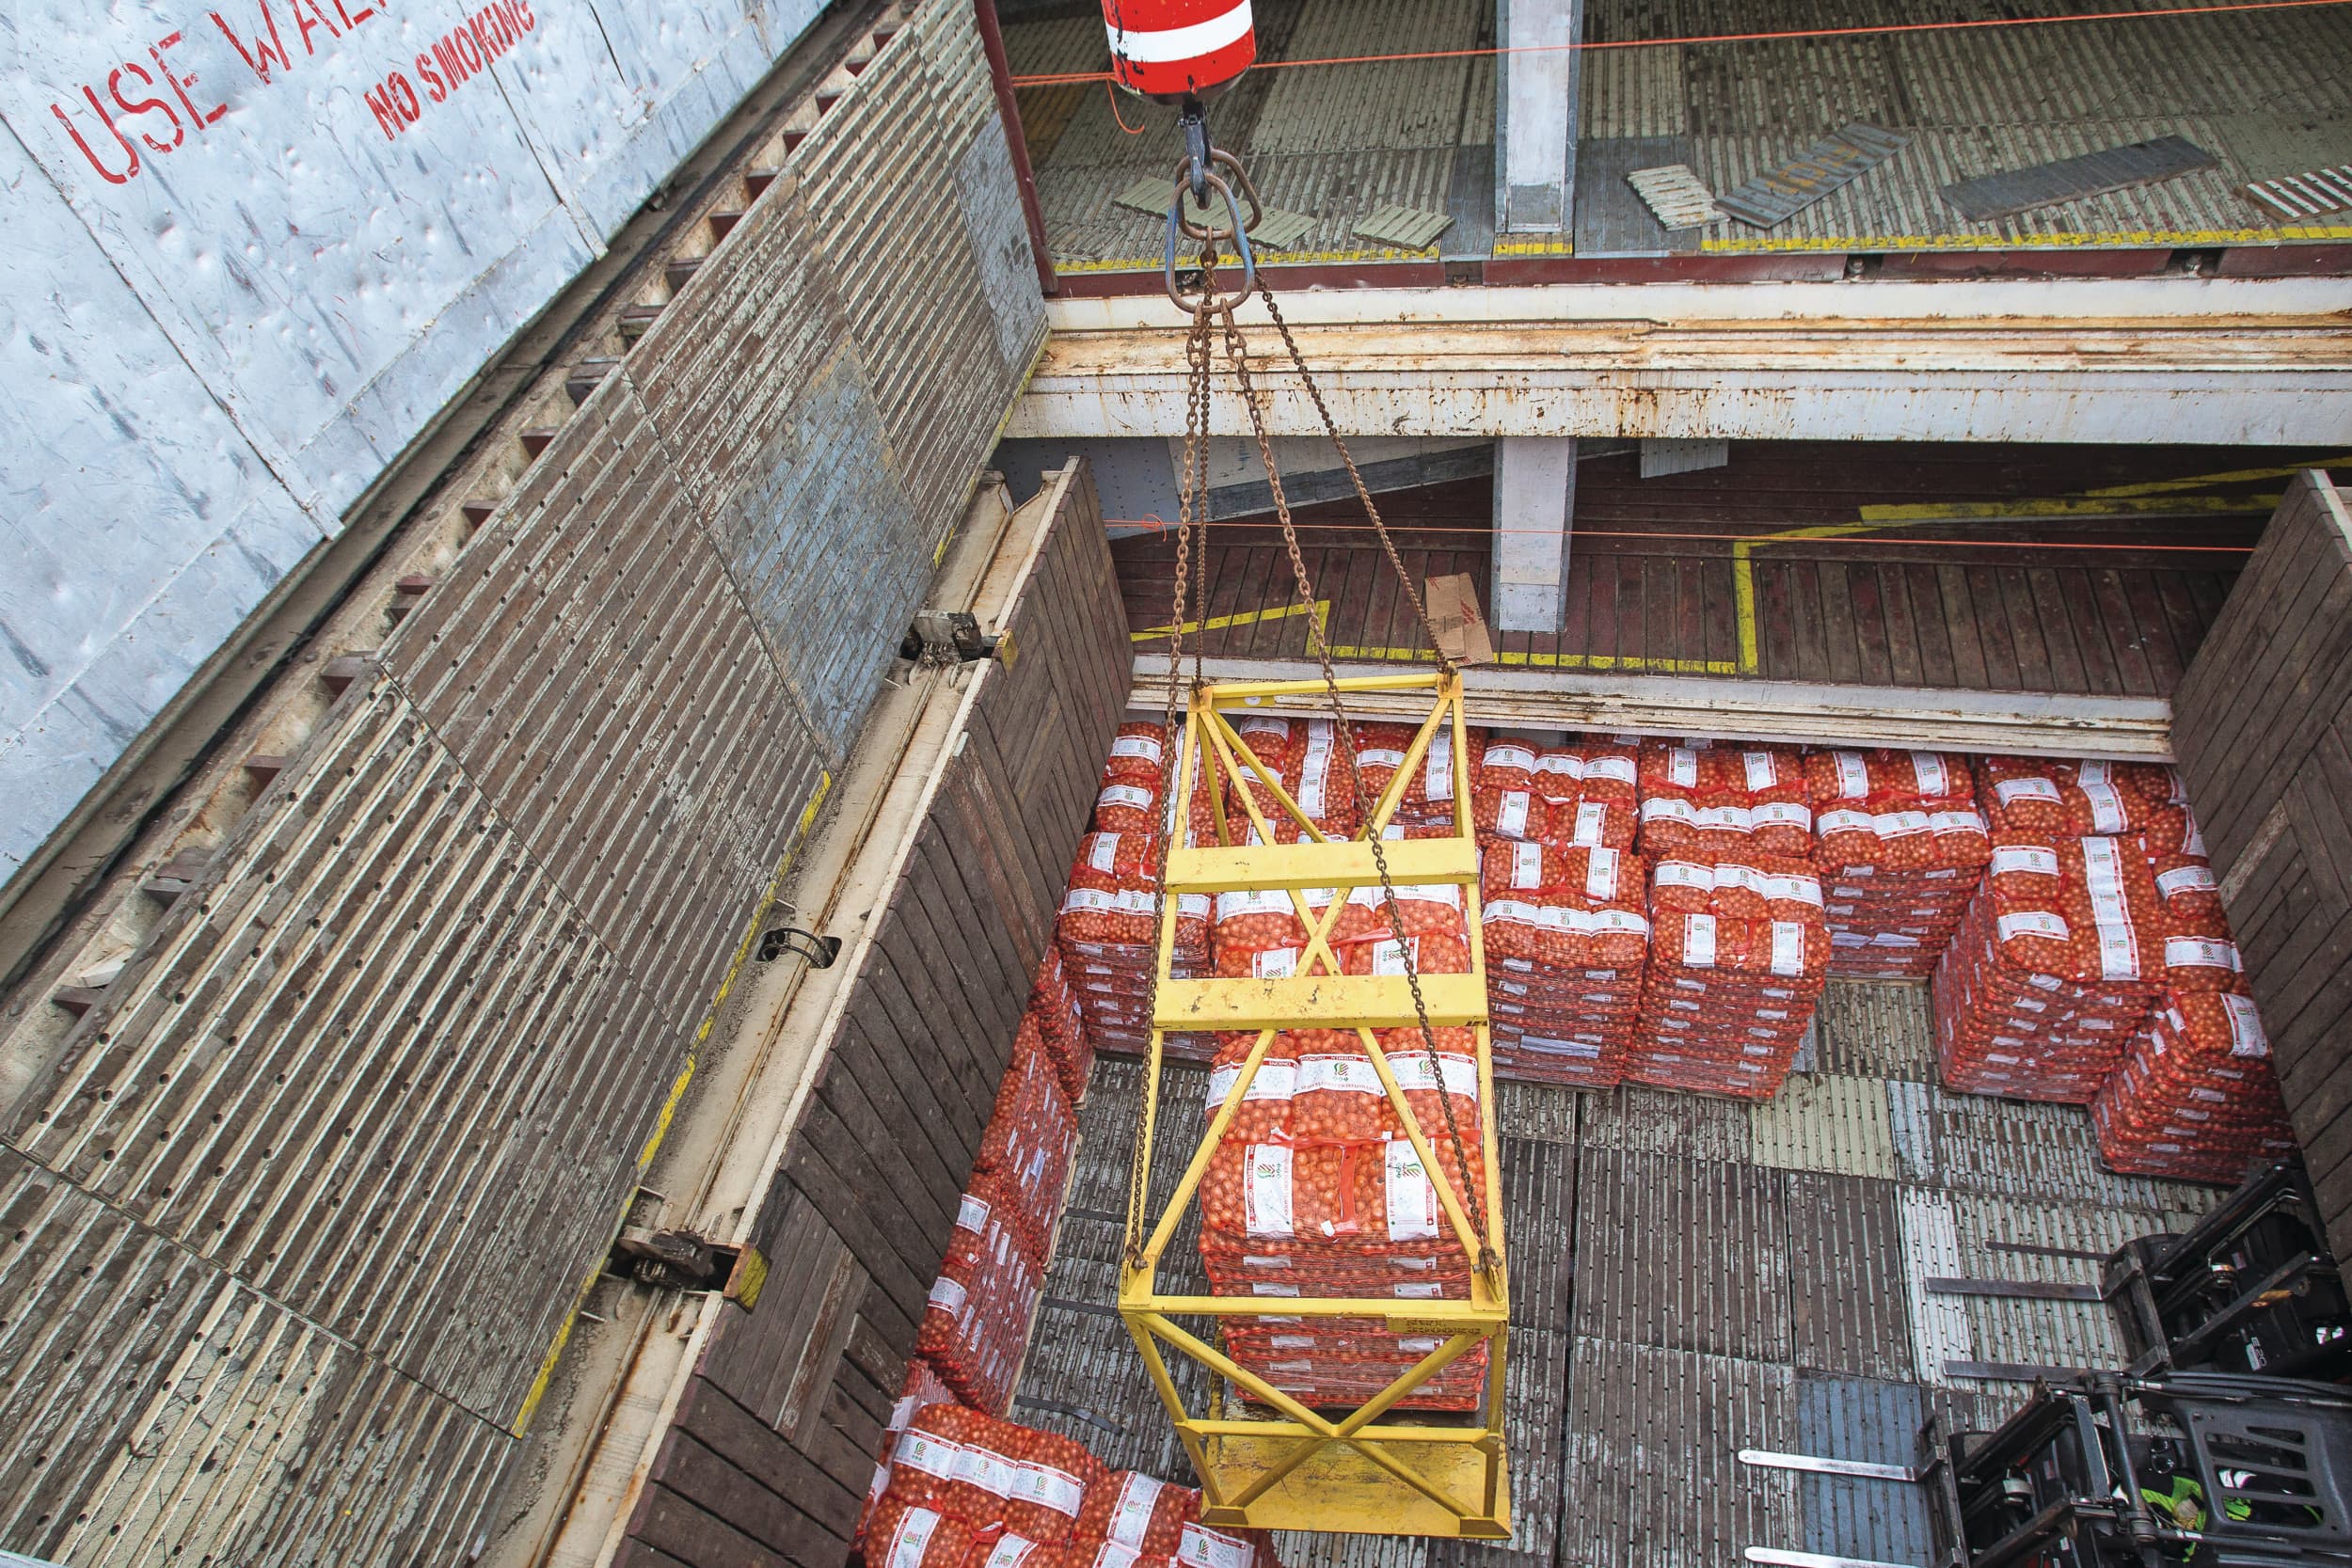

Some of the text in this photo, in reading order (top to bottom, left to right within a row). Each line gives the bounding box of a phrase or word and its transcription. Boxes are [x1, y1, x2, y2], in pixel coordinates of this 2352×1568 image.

[51, 0, 387, 184] USE WAL
[363, 0, 535, 141] NO SMOKING
